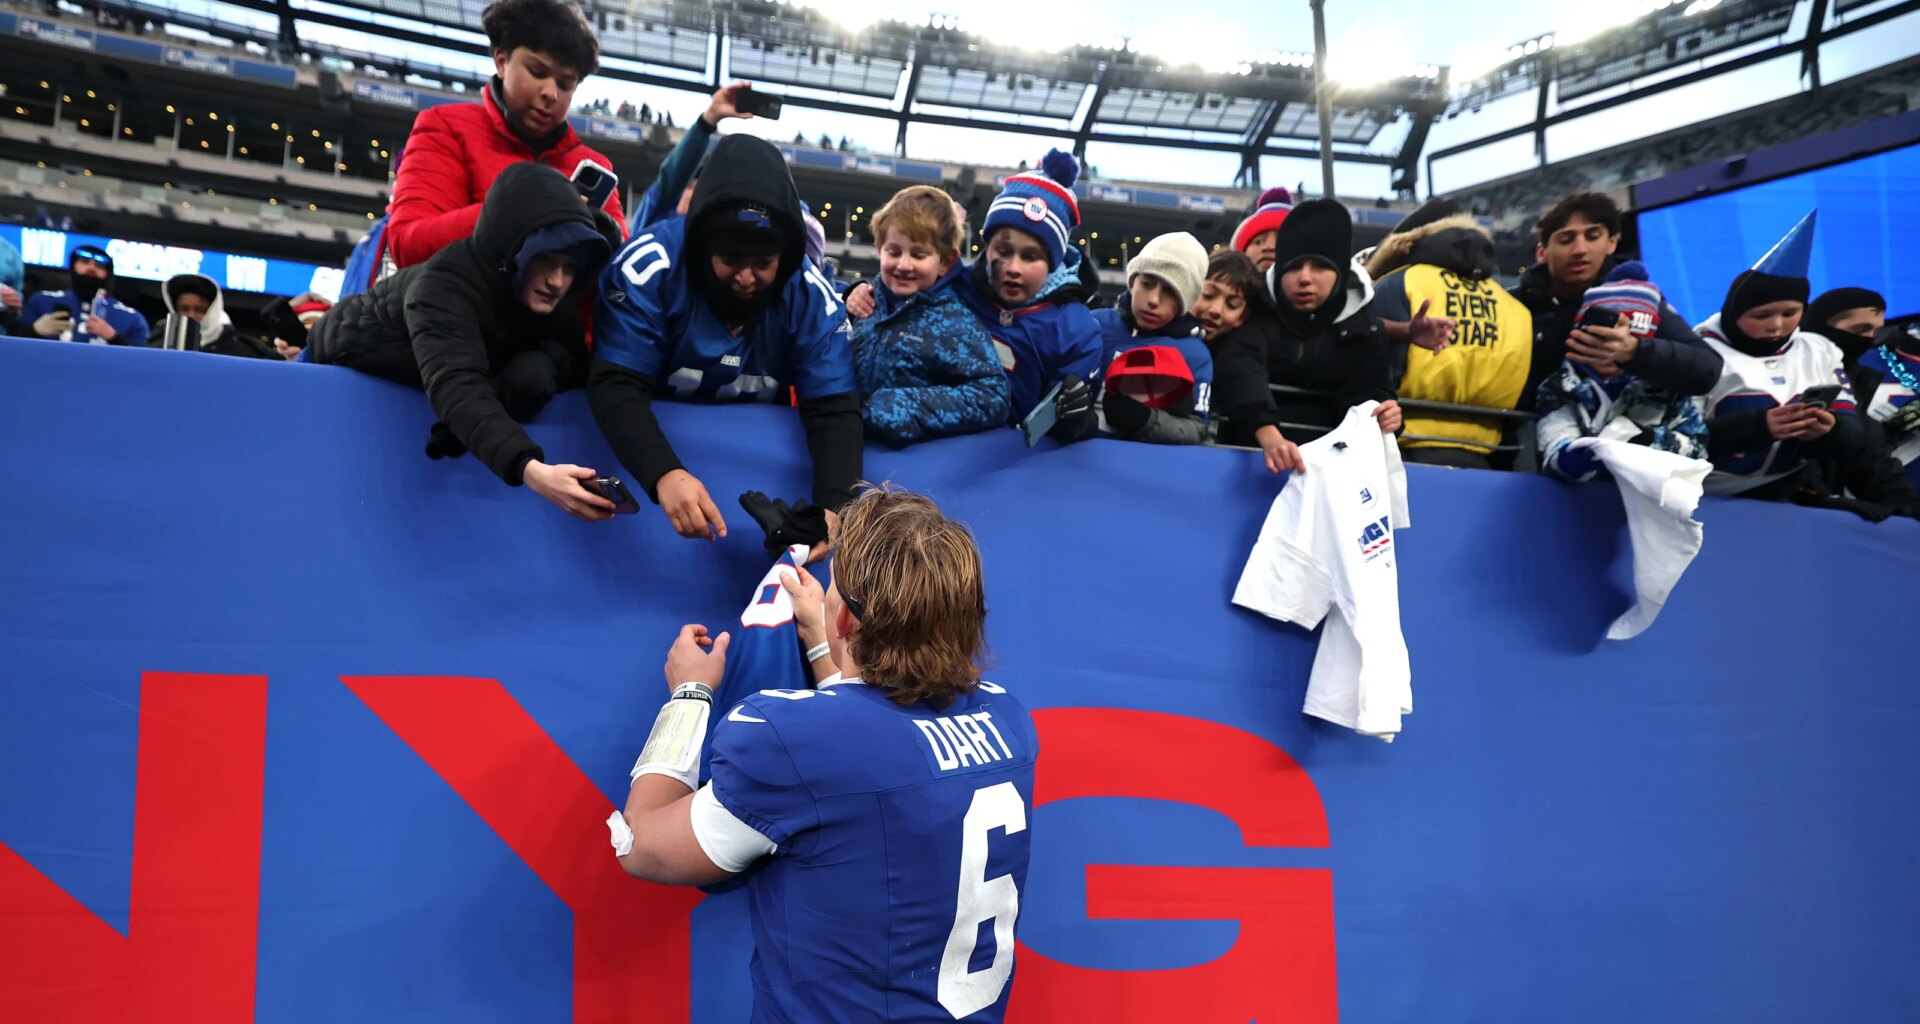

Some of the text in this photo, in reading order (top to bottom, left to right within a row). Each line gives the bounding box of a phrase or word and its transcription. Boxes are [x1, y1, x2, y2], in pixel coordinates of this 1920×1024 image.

[21, 226, 67, 267] WIN
[226, 254, 267, 292] WIN
[1446, 291, 1499, 323] EVENT
[912, 711, 1014, 772] DART
[937, 780, 1027, 1020] 6
